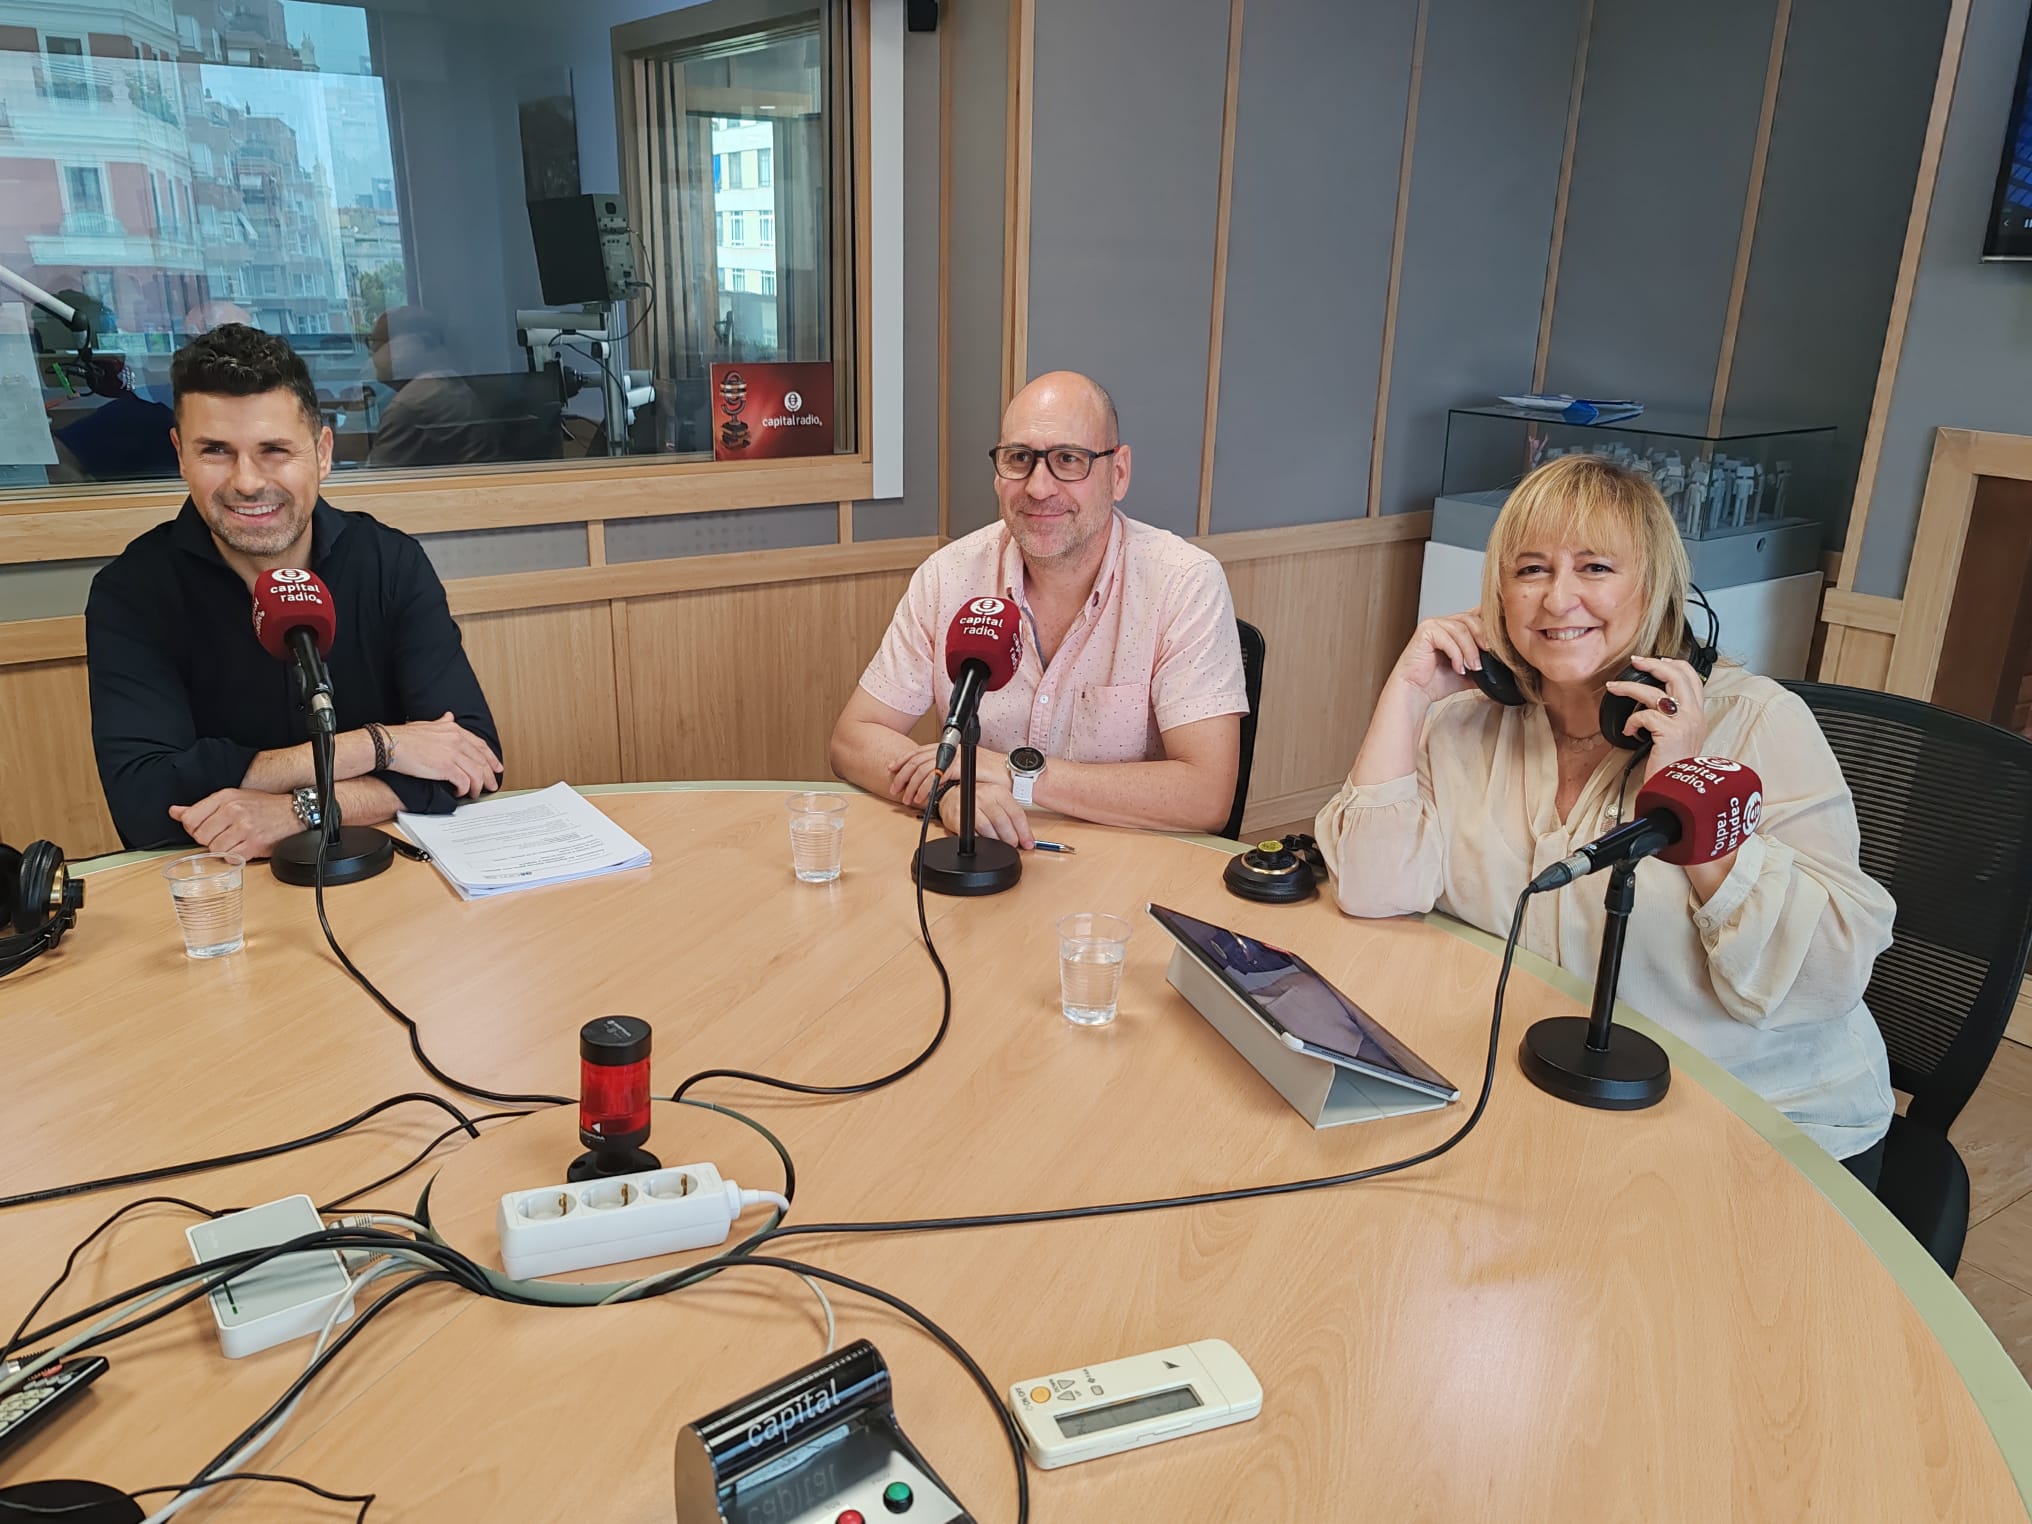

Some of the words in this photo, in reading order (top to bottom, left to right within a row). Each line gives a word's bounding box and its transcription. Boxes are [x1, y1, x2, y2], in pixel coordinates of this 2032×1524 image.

[270, 583, 321, 594] capital
[959, 616, 1004, 628] capital
[1669, 762, 1725, 785] capital
[1727, 797, 1742, 851] capital
[748, 1377, 841, 1447] capital
